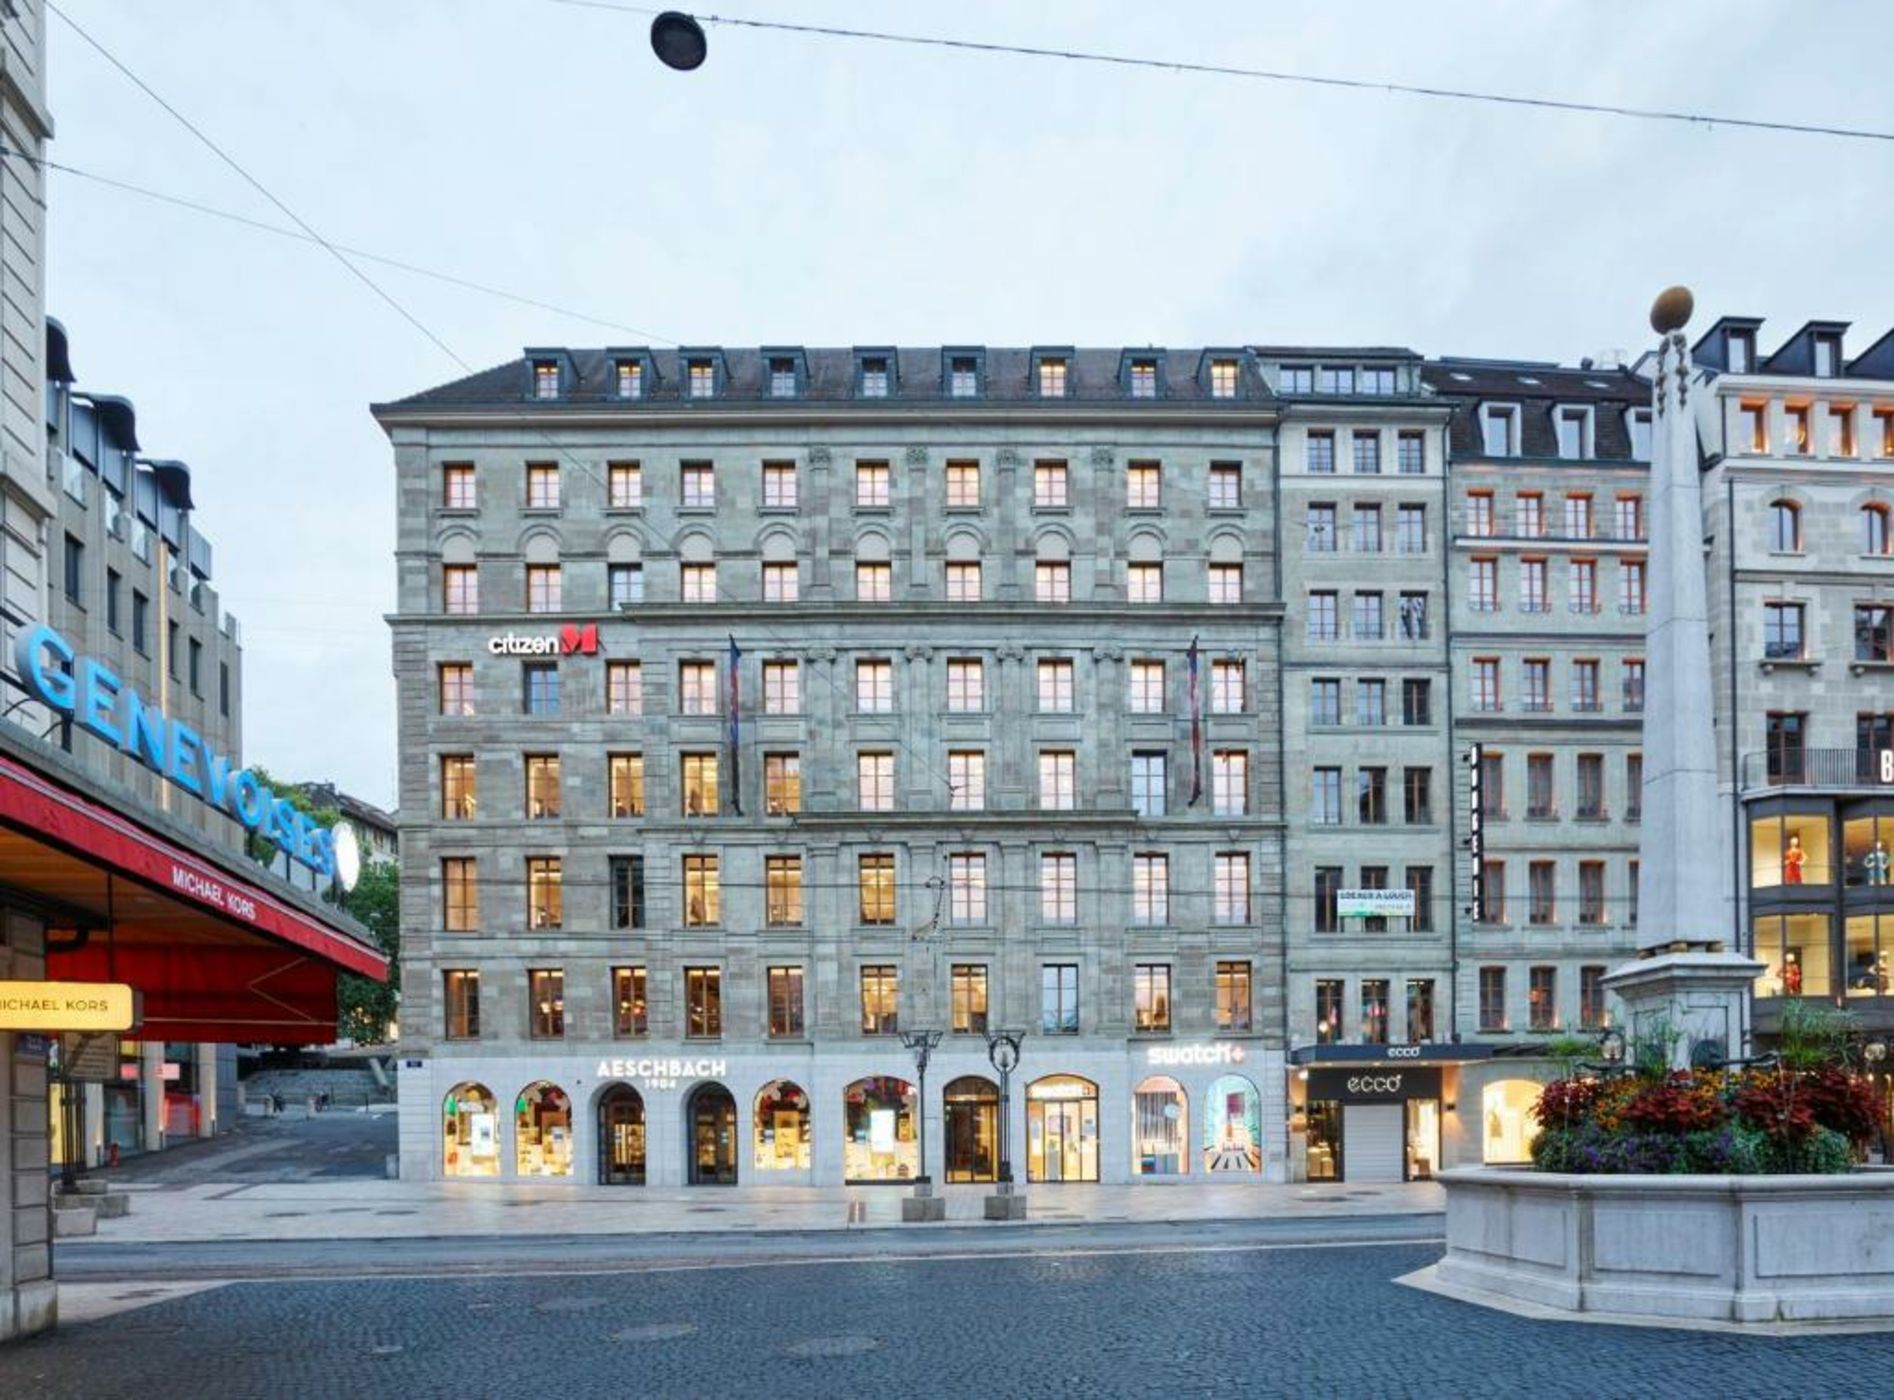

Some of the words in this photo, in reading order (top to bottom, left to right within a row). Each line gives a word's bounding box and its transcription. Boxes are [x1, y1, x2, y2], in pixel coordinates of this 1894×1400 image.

[171, 864, 224, 906] MICHAEL
[226, 891, 257, 920] KORS
[0, 999, 60, 1011] ICHAEL
[65, 1000, 108, 1011] KORS
[1147, 1043, 1232, 1065] swatch
[1387, 1047, 1420, 1058] ecco
[597, 1059, 727, 1077] AESCHBACH
[1347, 1074, 1402, 1093] ecco
